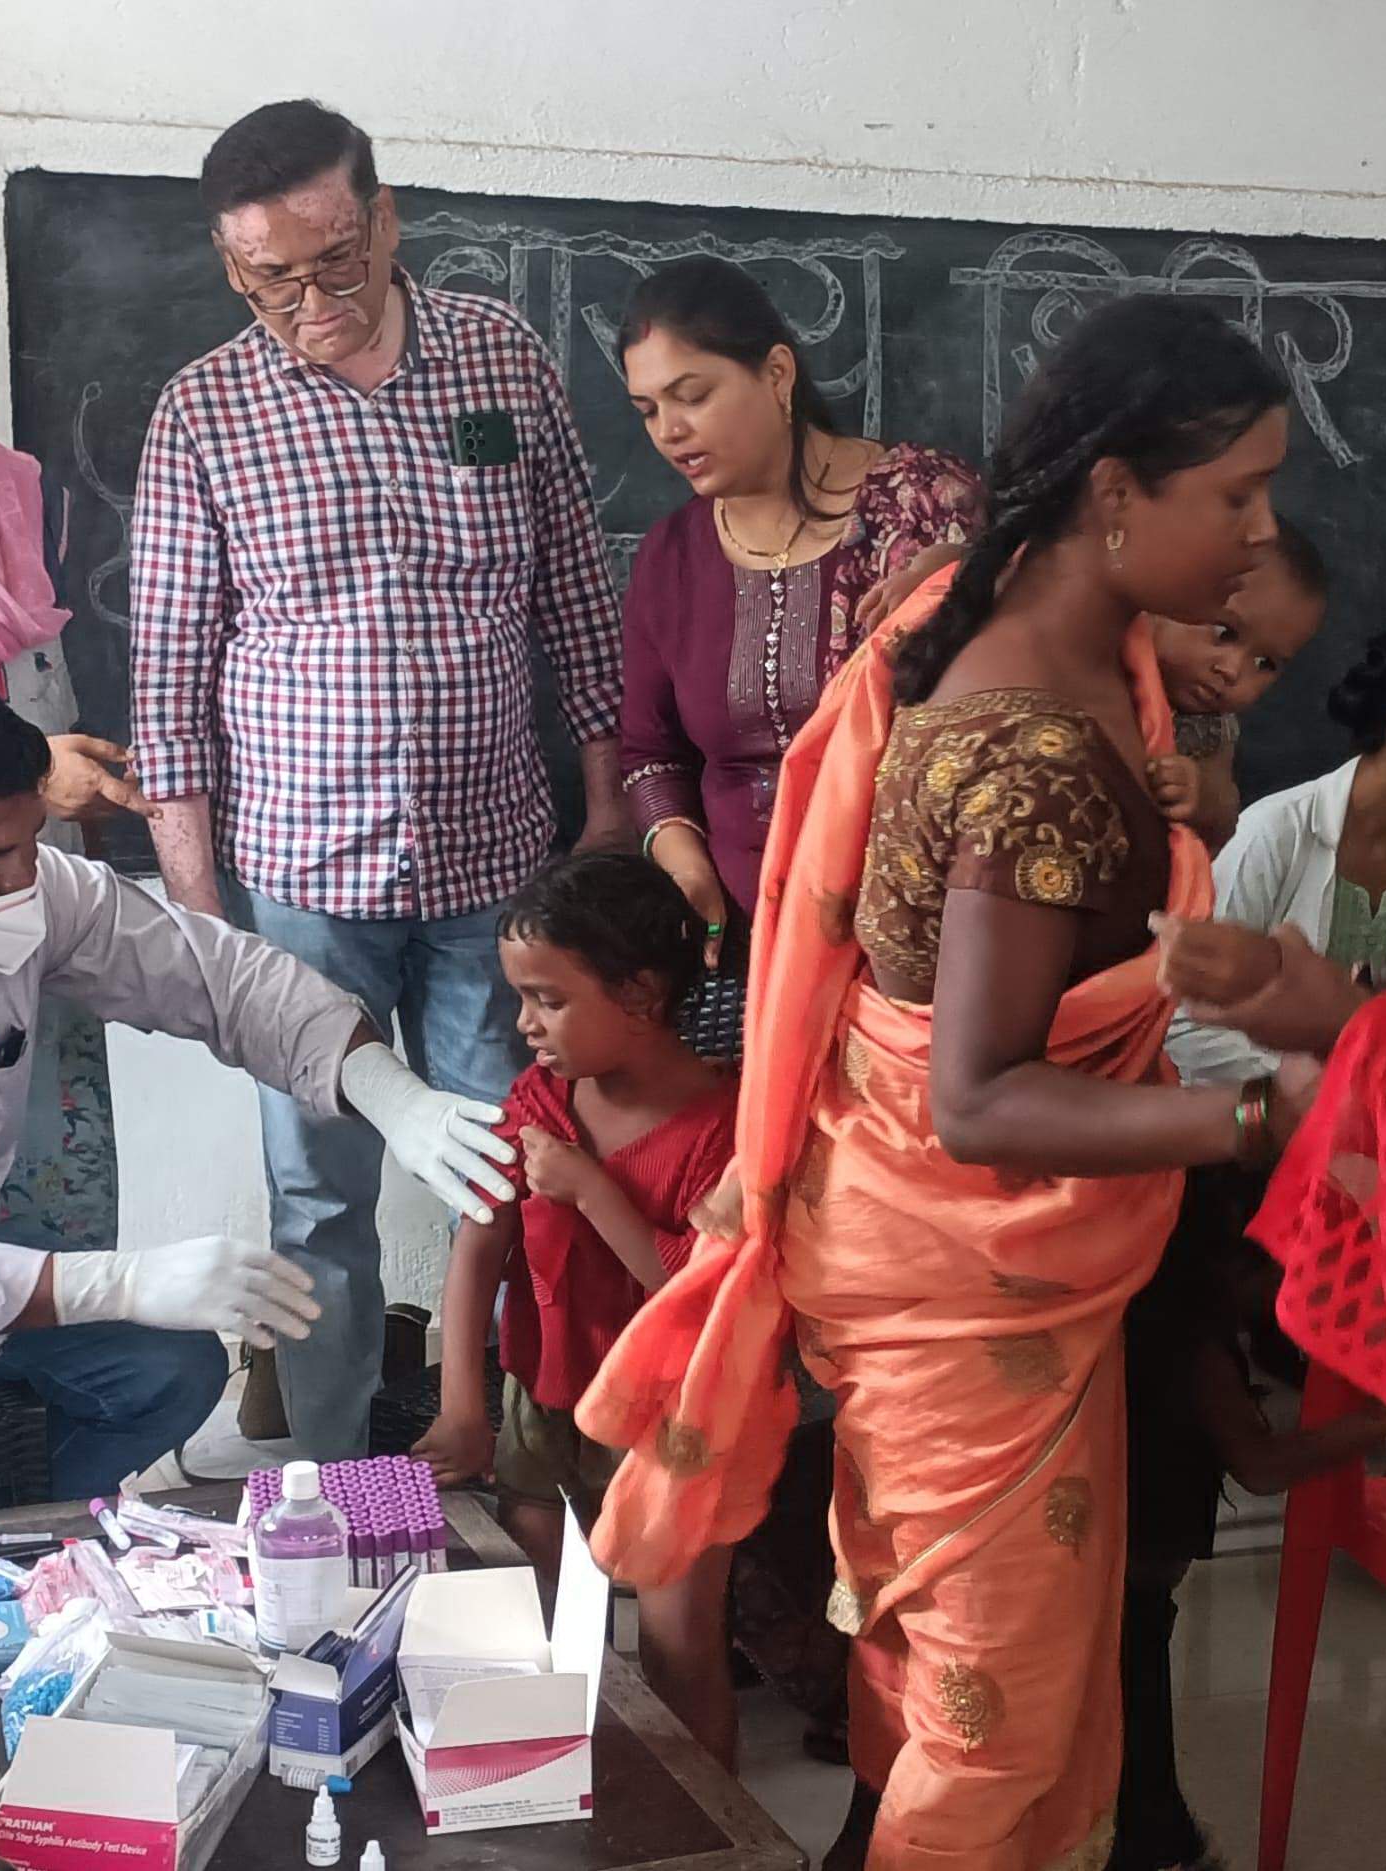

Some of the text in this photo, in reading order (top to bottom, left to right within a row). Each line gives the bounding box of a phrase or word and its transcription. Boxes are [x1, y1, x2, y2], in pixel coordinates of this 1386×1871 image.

[16, 1832, 33, 1845] Step
[34, 1834, 65, 1847] Syphilis
[66, 1838, 102, 1853] Antibody
[103, 1841, 120, 1853] Test
[121, 1843, 148, 1856] Device
